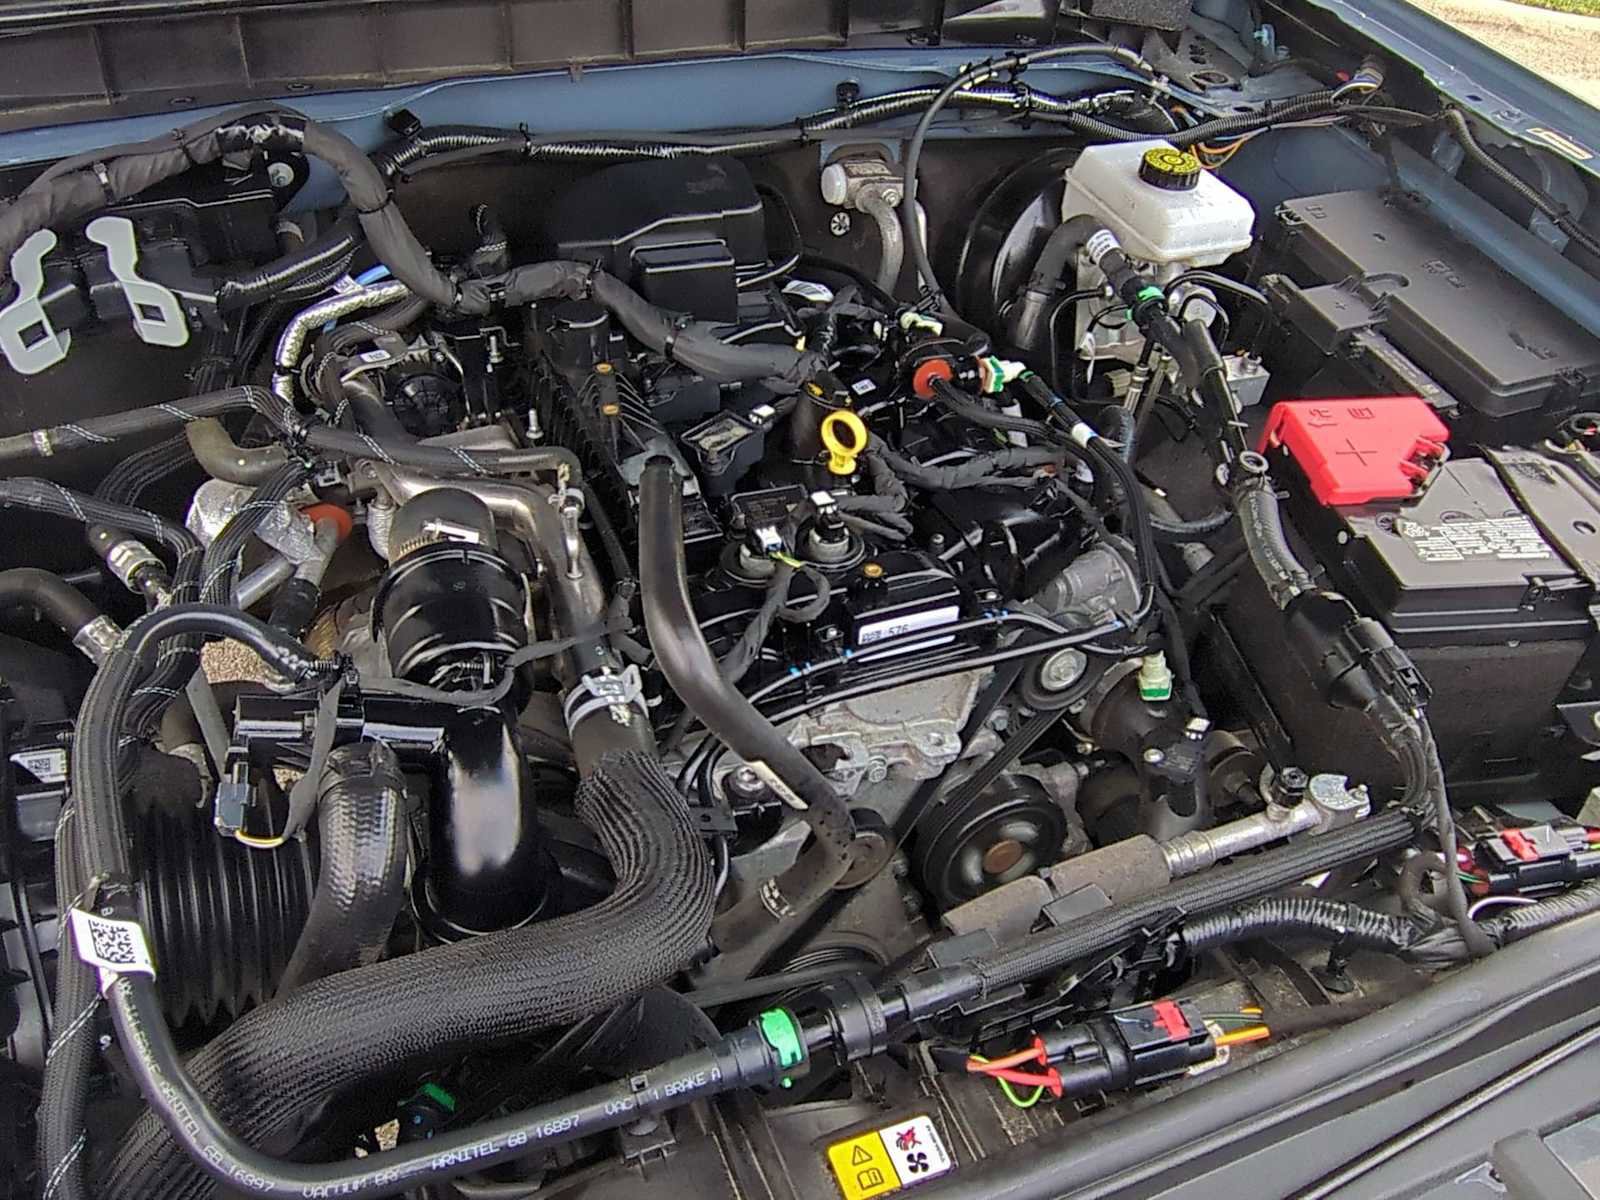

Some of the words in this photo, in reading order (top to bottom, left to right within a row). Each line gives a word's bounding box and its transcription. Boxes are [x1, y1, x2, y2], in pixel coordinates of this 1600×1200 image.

[432, 1140, 499, 1171] ARNITEL
[536, 1113, 580, 1139] 16897
[664, 1072, 707, 1097] BRAKE
